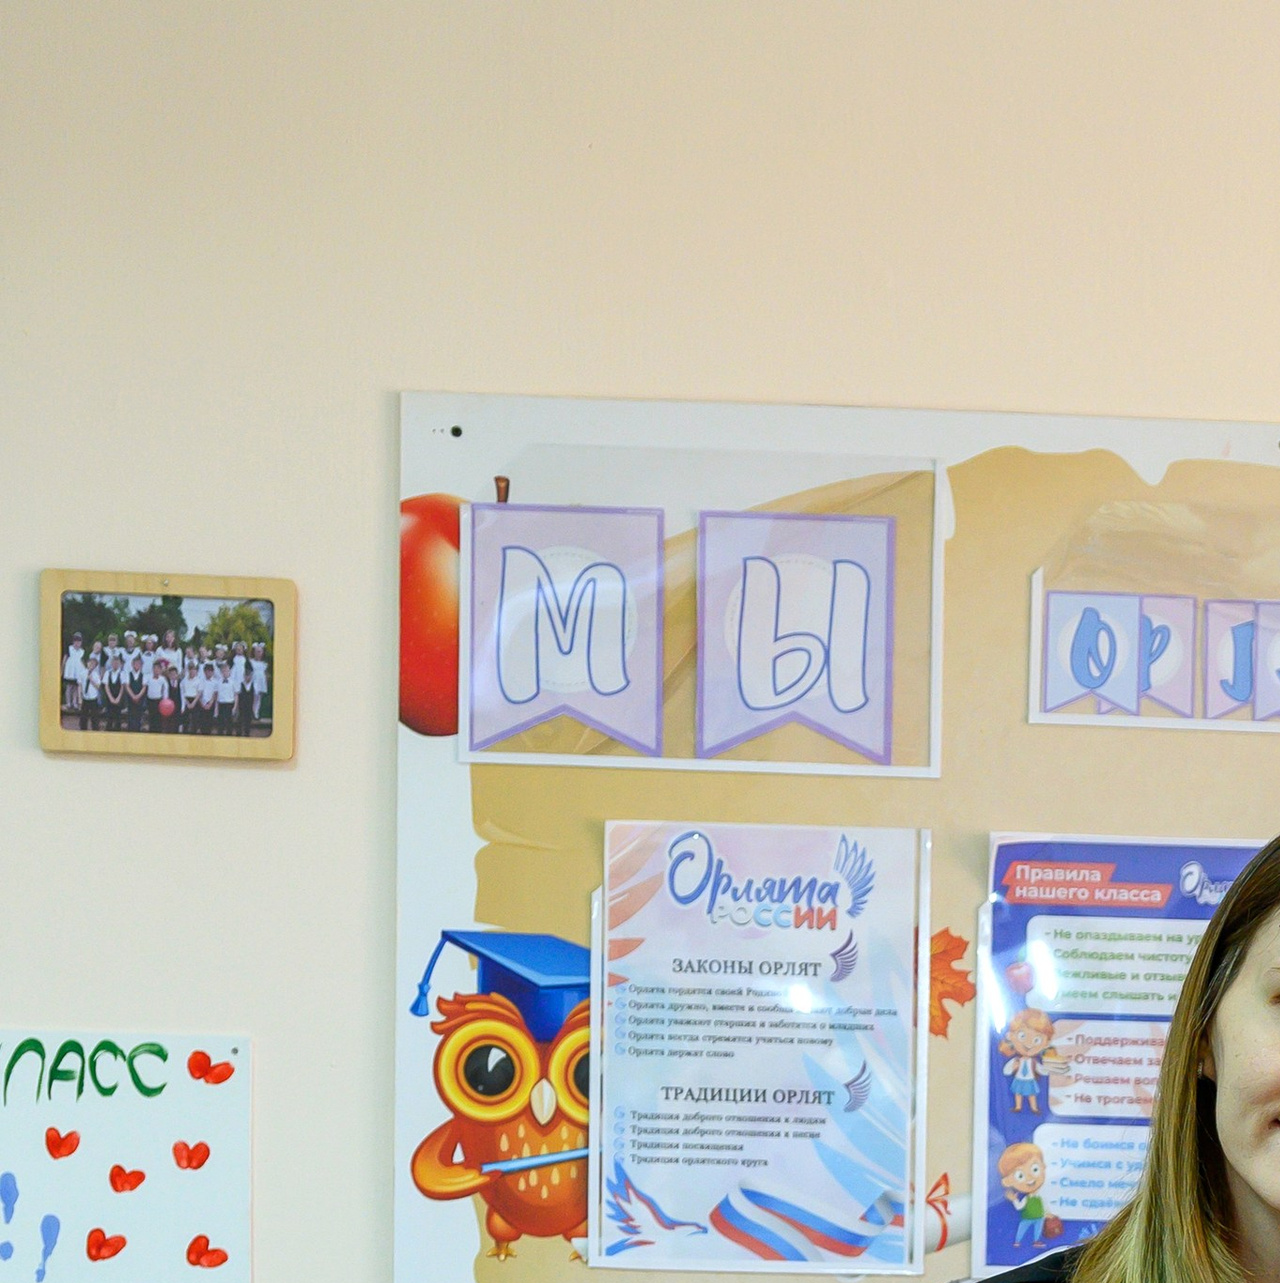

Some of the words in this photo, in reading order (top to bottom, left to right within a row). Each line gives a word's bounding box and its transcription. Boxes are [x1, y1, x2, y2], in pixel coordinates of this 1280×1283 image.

[498, 546, 871, 714] МЫ
[667, 829, 841, 915] Орлята
[1015, 864, 1101, 883] Правила
[1015, 885, 1089, 900] нашего
[1094, 887, 1163, 902] класса
[1053, 930, 1071, 940] Не
[1076, 932, 1163, 943] опаздываем
[1166, 934, 1183, 943] на
[1054, 948, 1135, 962] Соблюдаем
[1138, 951, 1193, 965] чистоту
[672, 957, 754, 976] ЗАКОНЫ
[758, 960, 822, 977] ОРЛЯТ
[1058, 968, 1127, 981] ежливые
[1131, 972, 1140, 981] и
[1057, 989, 1099, 1000] меем
[1102, 990, 1164, 1002] слышать
[1075, 1034, 1167, 1048] Поддержива
[1074, 1054, 1143, 1065] Отвечаем
[0, 1037, 169, 1107] ЛАСС
[1074, 1073, 1130, 1085] Решаем
[661, 1085, 767, 1104] ТРАДИЦИИ
[773, 1089, 835, 1105] ОРЛЯТ
[1074, 1093, 1092, 1103] Не
[1061, 1138, 1078, 1149] Не
[1083, 1138, 1134, 1150] боимся
[1060, 1157, 1112, 1170] Учимся
[1060, 1177, 1104, 1188] Смело
[1060, 1196, 1077, 1207] Не
